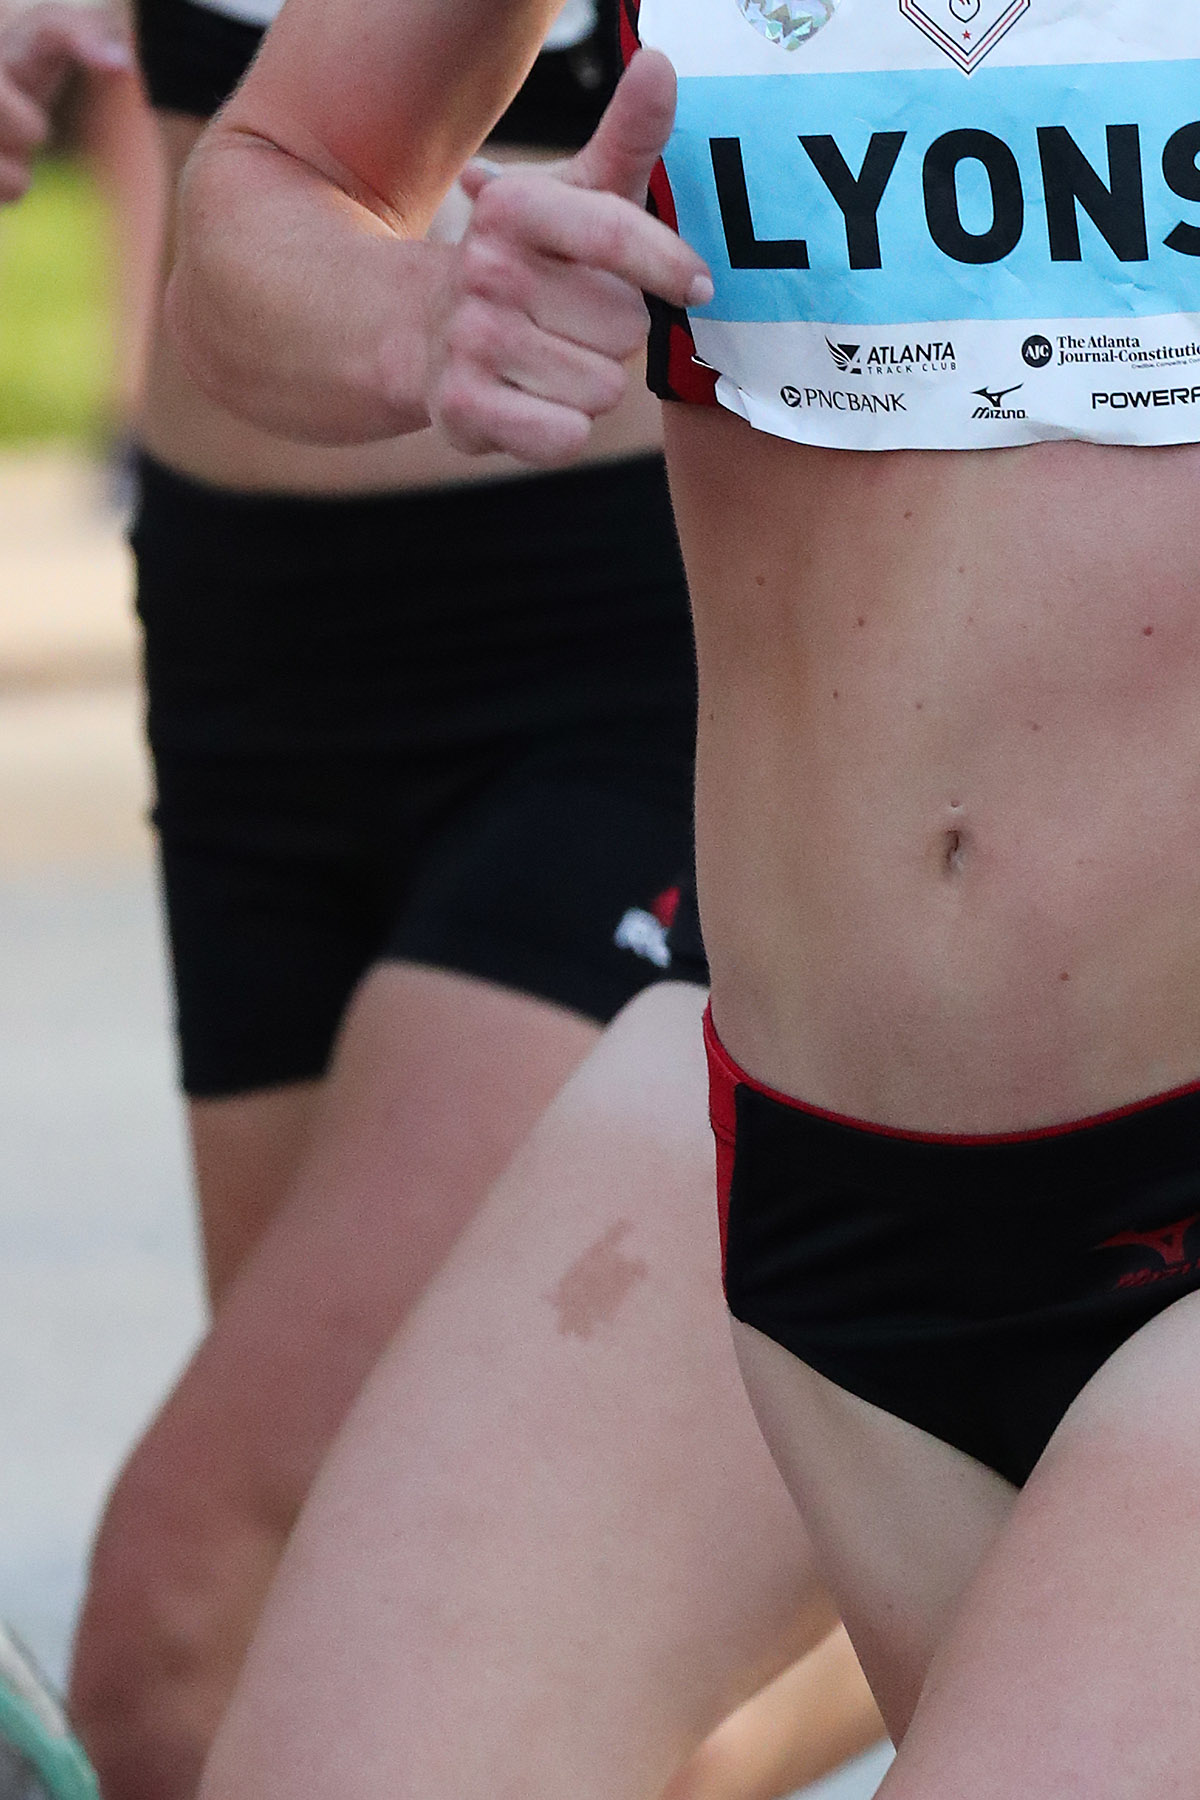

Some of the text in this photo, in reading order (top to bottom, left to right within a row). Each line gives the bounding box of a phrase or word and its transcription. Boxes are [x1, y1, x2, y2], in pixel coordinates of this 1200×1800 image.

[1057, 335, 1140, 348] The Atlanta
[867, 342, 956, 365] ATLANTA
[1025, 344, 1049, 360] AJC
[867, 363, 957, 375] TRACK CLUB
